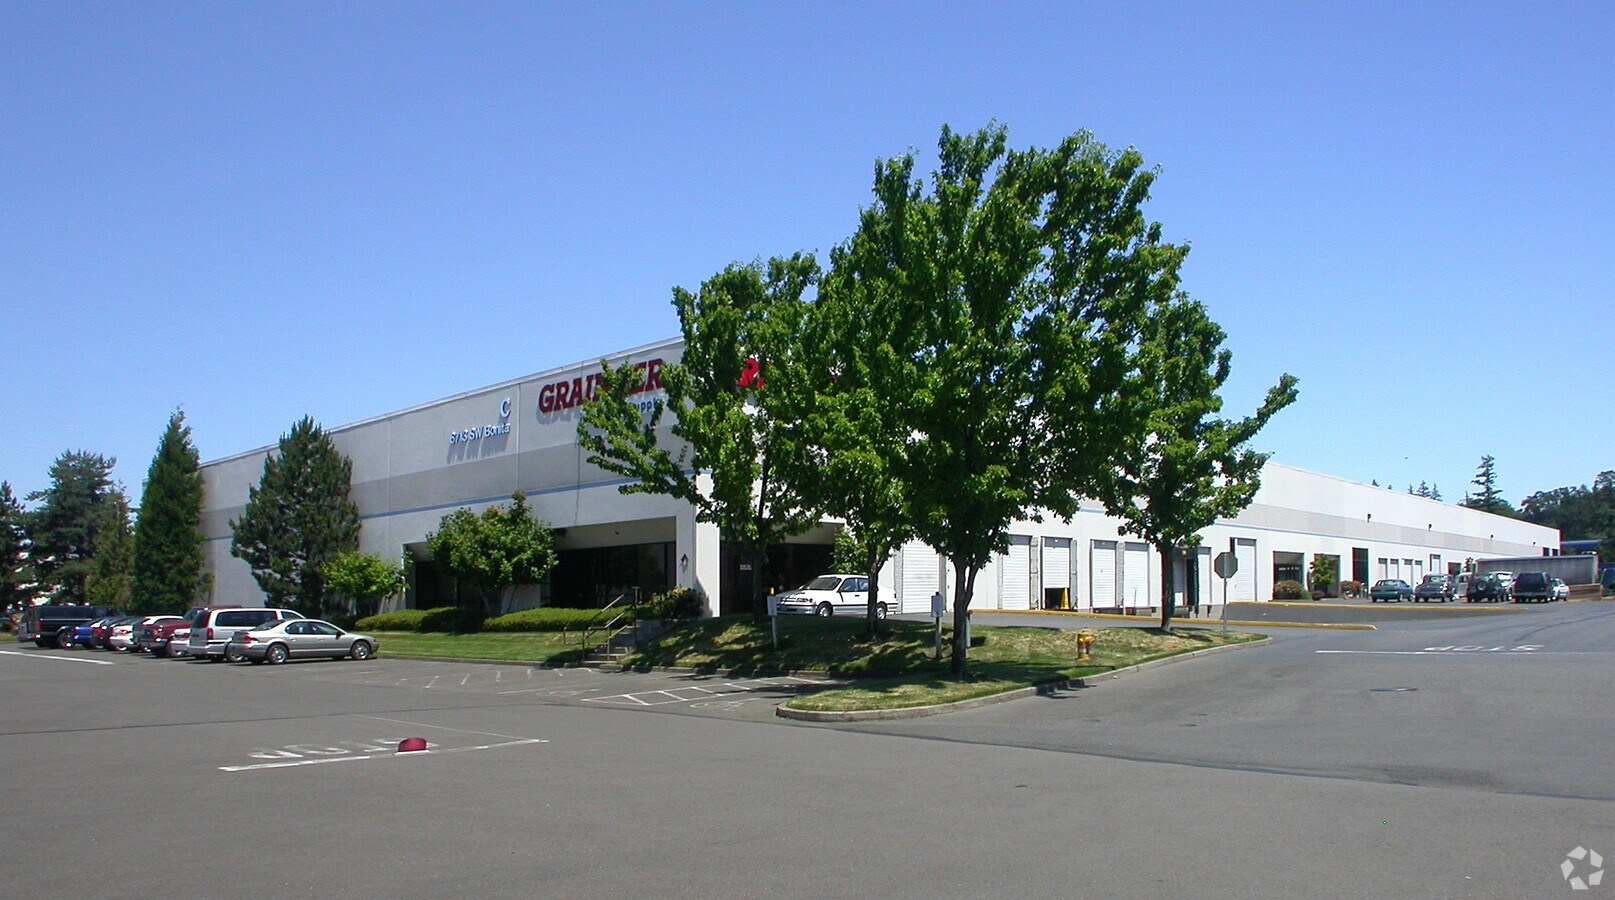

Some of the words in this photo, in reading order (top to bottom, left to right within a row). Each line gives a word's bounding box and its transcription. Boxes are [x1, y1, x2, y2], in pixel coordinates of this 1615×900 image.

[538, 358, 665, 413] GRAIER
[501, 397, 511, 417] C
[450, 431, 468, 444] 6713
[469, 427, 484, 440] SW
[484, 422, 510, 437] Bonita
